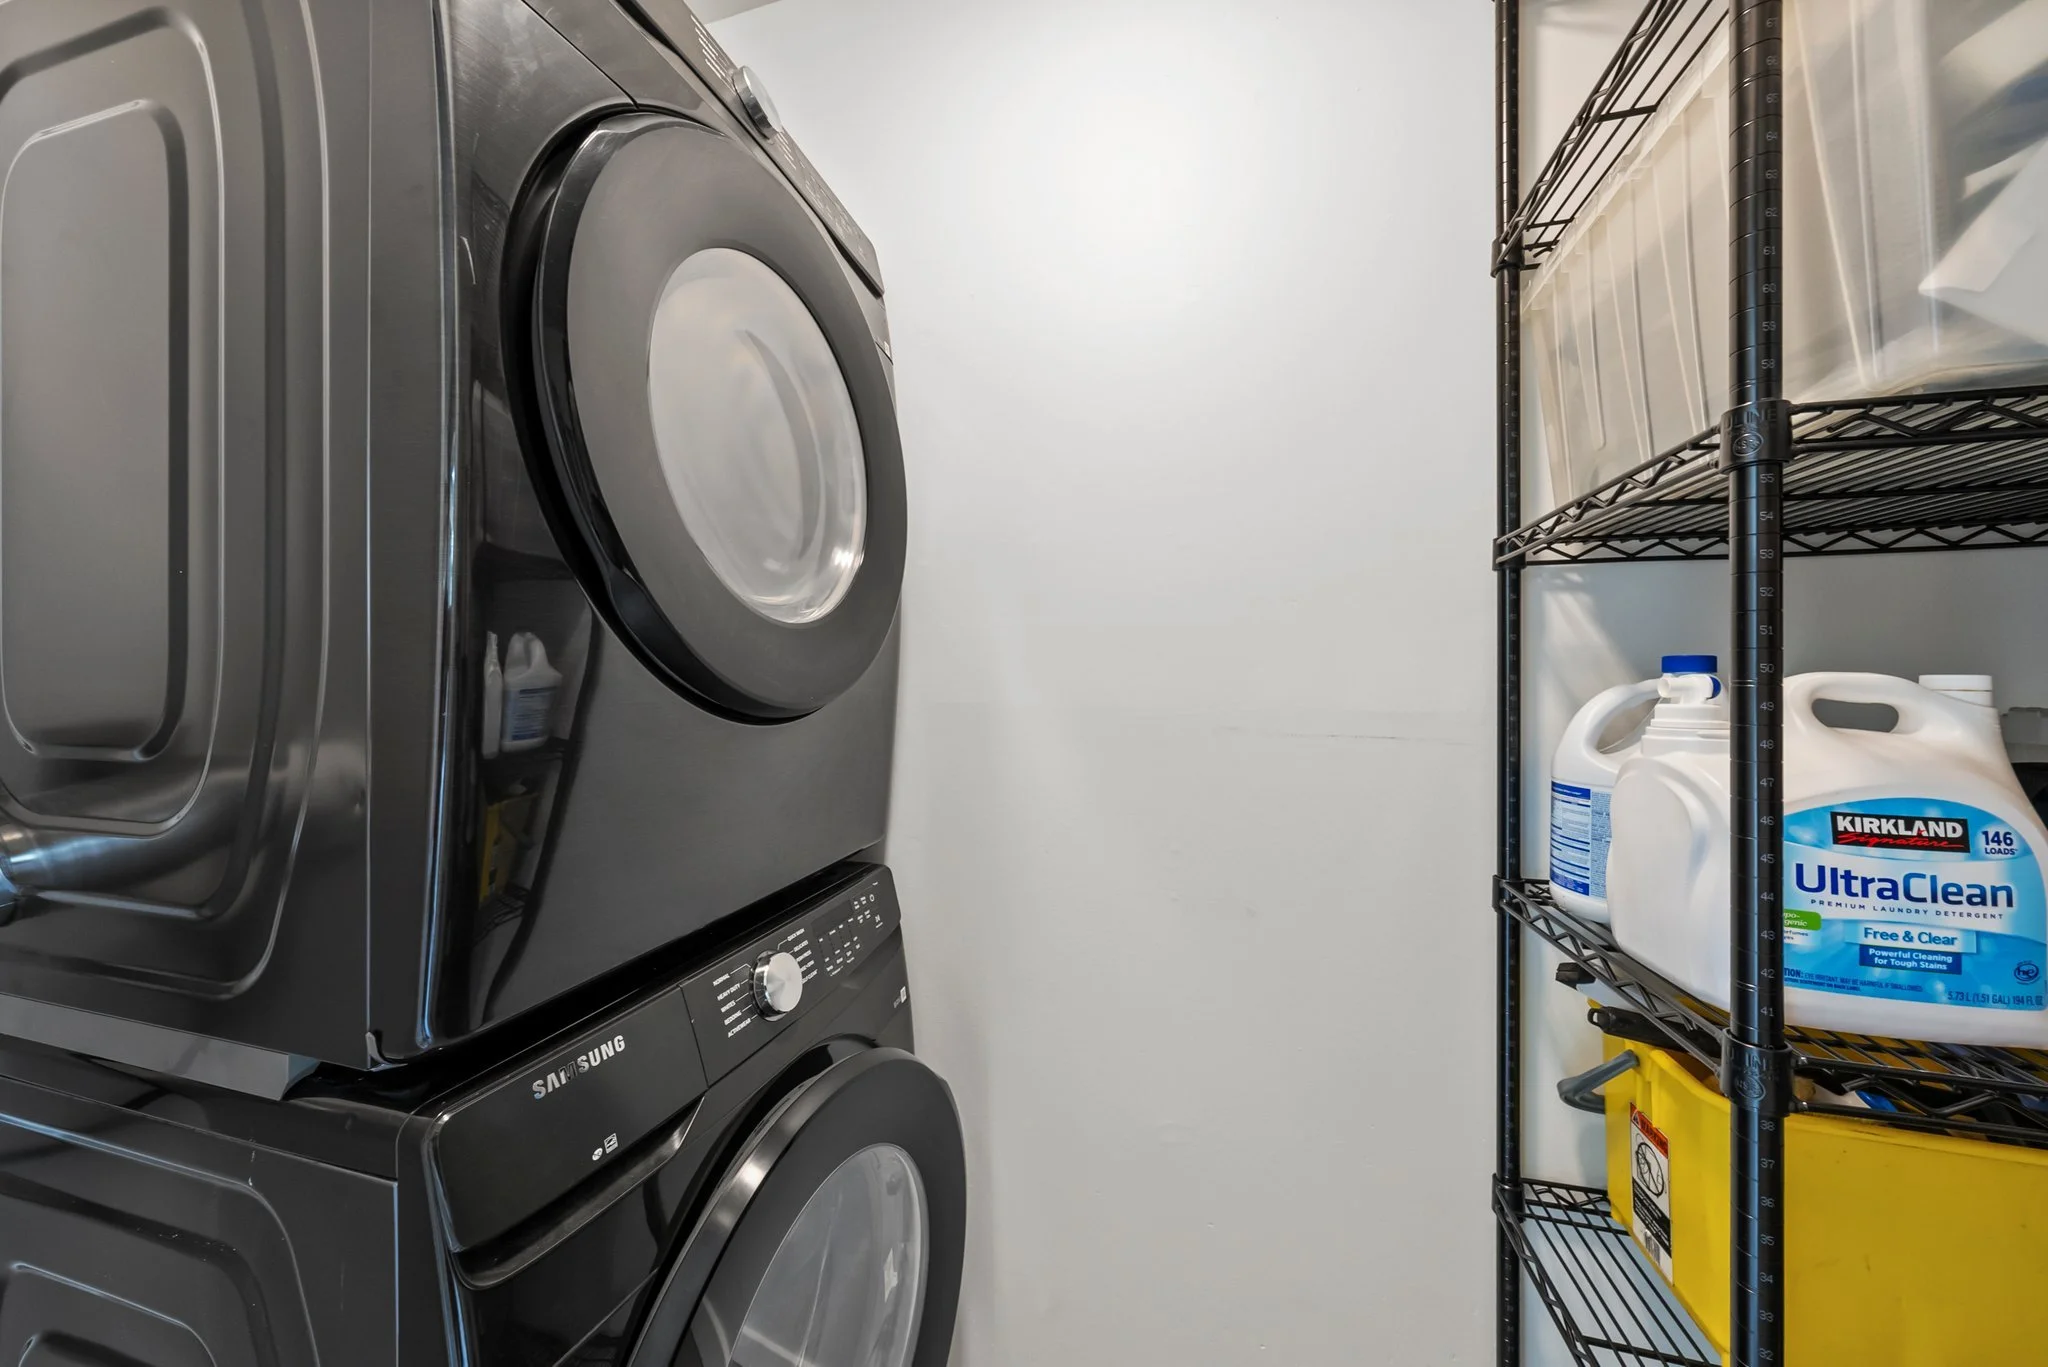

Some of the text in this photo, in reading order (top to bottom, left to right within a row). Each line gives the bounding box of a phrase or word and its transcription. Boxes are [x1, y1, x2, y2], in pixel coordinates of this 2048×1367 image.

[1766, 131, 1778, 141] 64
[1763, 246, 1776, 255] 61
[1762, 321, 1776, 331] 59
[1761, 359, 1775, 369] 58
[1760, 473, 1775, 483] 55
[1760, 511, 1774, 521] 54
[1760, 549, 1775, 559] 53
[1760, 587, 1775, 597] 52
[1760, 625, 1774, 635] 51
[1760, 663, 1775, 673] 50
[1760, 701, 1775, 711] 49
[1760, 739, 1775, 749] 48
[1760, 777, 1775, 787] 47
[1760, 815, 1775, 826] 46
[1836, 815, 1963, 838] KIRKLAND
[1837, 831, 1965, 847] Signature
[1982, 830, 2013, 846] 146
[1760, 853, 1775, 864] 45
[1795, 862, 2014, 908] UltraClean
[1760, 891, 1775, 901] 44
[1810, 899, 2004, 920] PREMIUM LAUNDRY DETERGENT
[1760, 929, 1775, 940] 43
[1864, 927, 1957, 946] Free & Clear
[1869, 948, 1953, 963] Powerful Cleaning
[1874, 957, 1947, 970] for Tough Stains
[1760, 968, 1775, 978] 42
[1784, 967, 1804, 978] TION:
[1760, 1006, 1775, 1017] 41
[532, 1035, 625, 1100] SAMSUNG
[1760, 1119, 1775, 1131] 38
[1760, 1158, 1775, 1169] 37
[1760, 1196, 1775, 1208] 36
[1760, 1234, 1775, 1246] 35
[1760, 1272, 1774, 1284] 34
[1760, 1310, 1775, 1322] 33
[1760, 1348, 1774, 1361] 32
